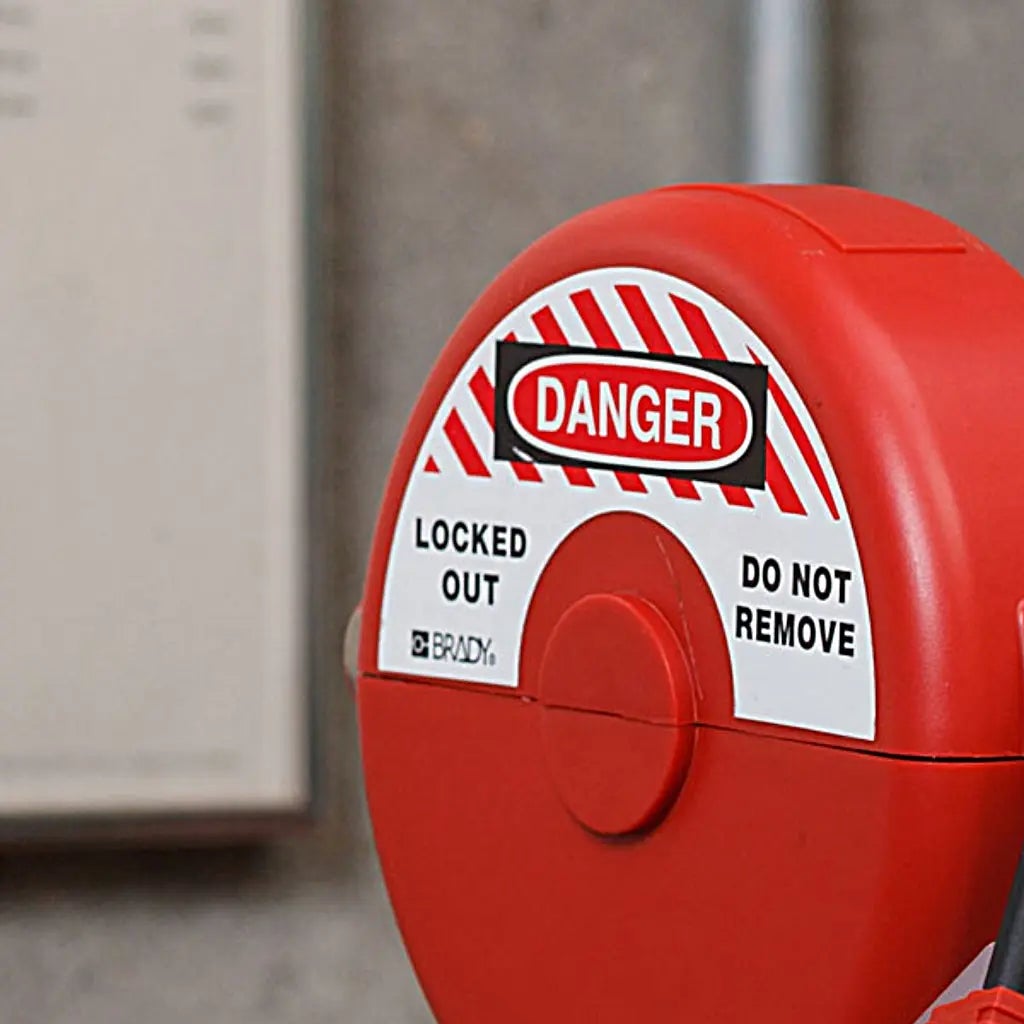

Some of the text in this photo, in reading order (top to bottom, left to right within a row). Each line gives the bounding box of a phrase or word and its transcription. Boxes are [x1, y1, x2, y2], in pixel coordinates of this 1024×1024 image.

[537, 376, 722, 450] DANGER
[415, 518, 527, 558] LOCKED
[442, 569, 499, 605] OUT
[742, 555, 852, 604] DO NOT
[735, 605, 856, 657] REMOVE
